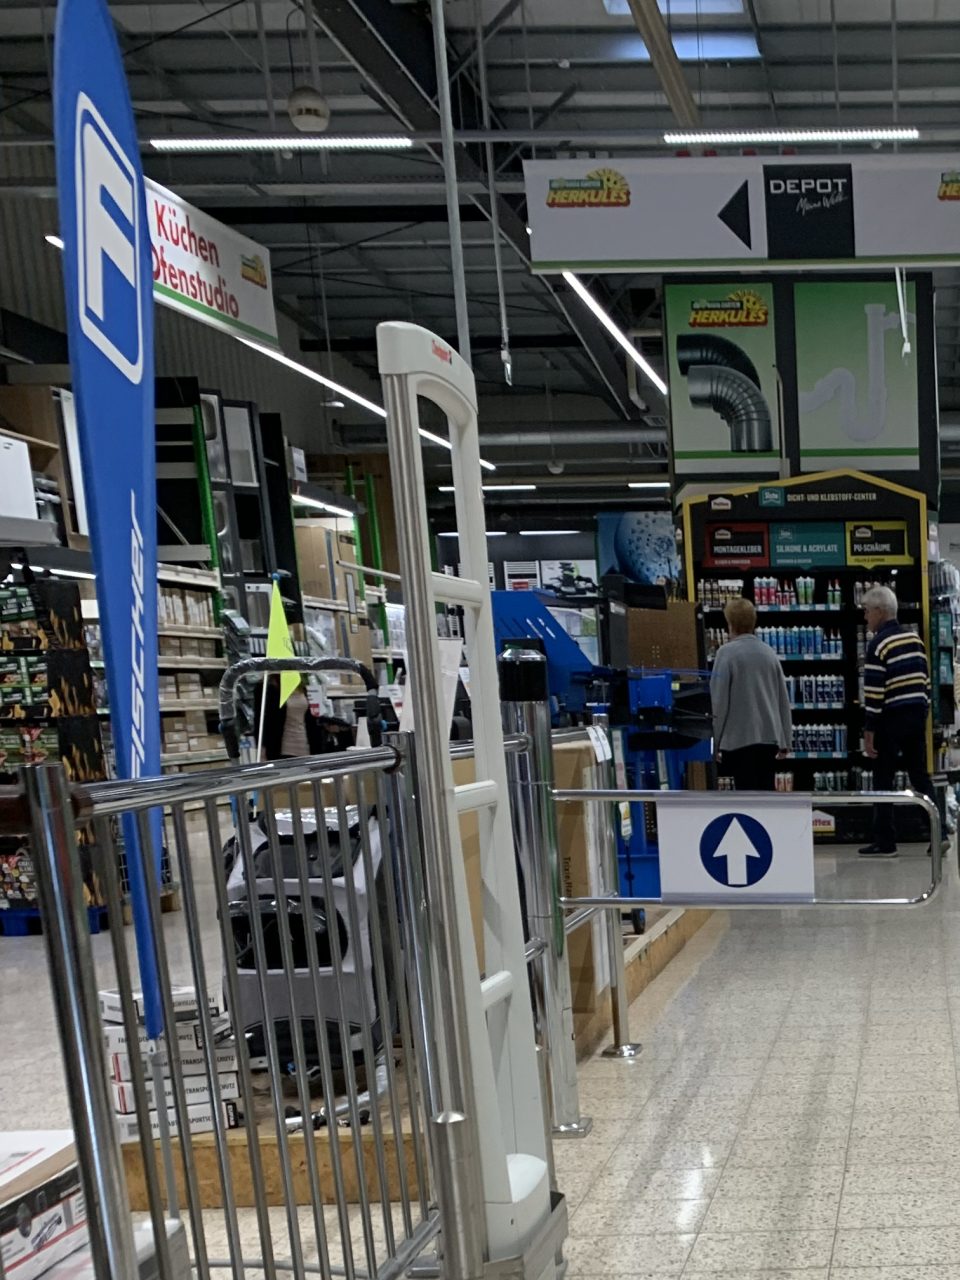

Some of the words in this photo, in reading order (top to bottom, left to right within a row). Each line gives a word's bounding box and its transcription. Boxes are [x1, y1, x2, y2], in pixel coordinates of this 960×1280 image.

[769, 178, 848, 194] DEPOT
[546, 189, 630, 207] HERKULES
[154, 199, 220, 268] Küchen
[689, 309, 768, 327] HERKULES
